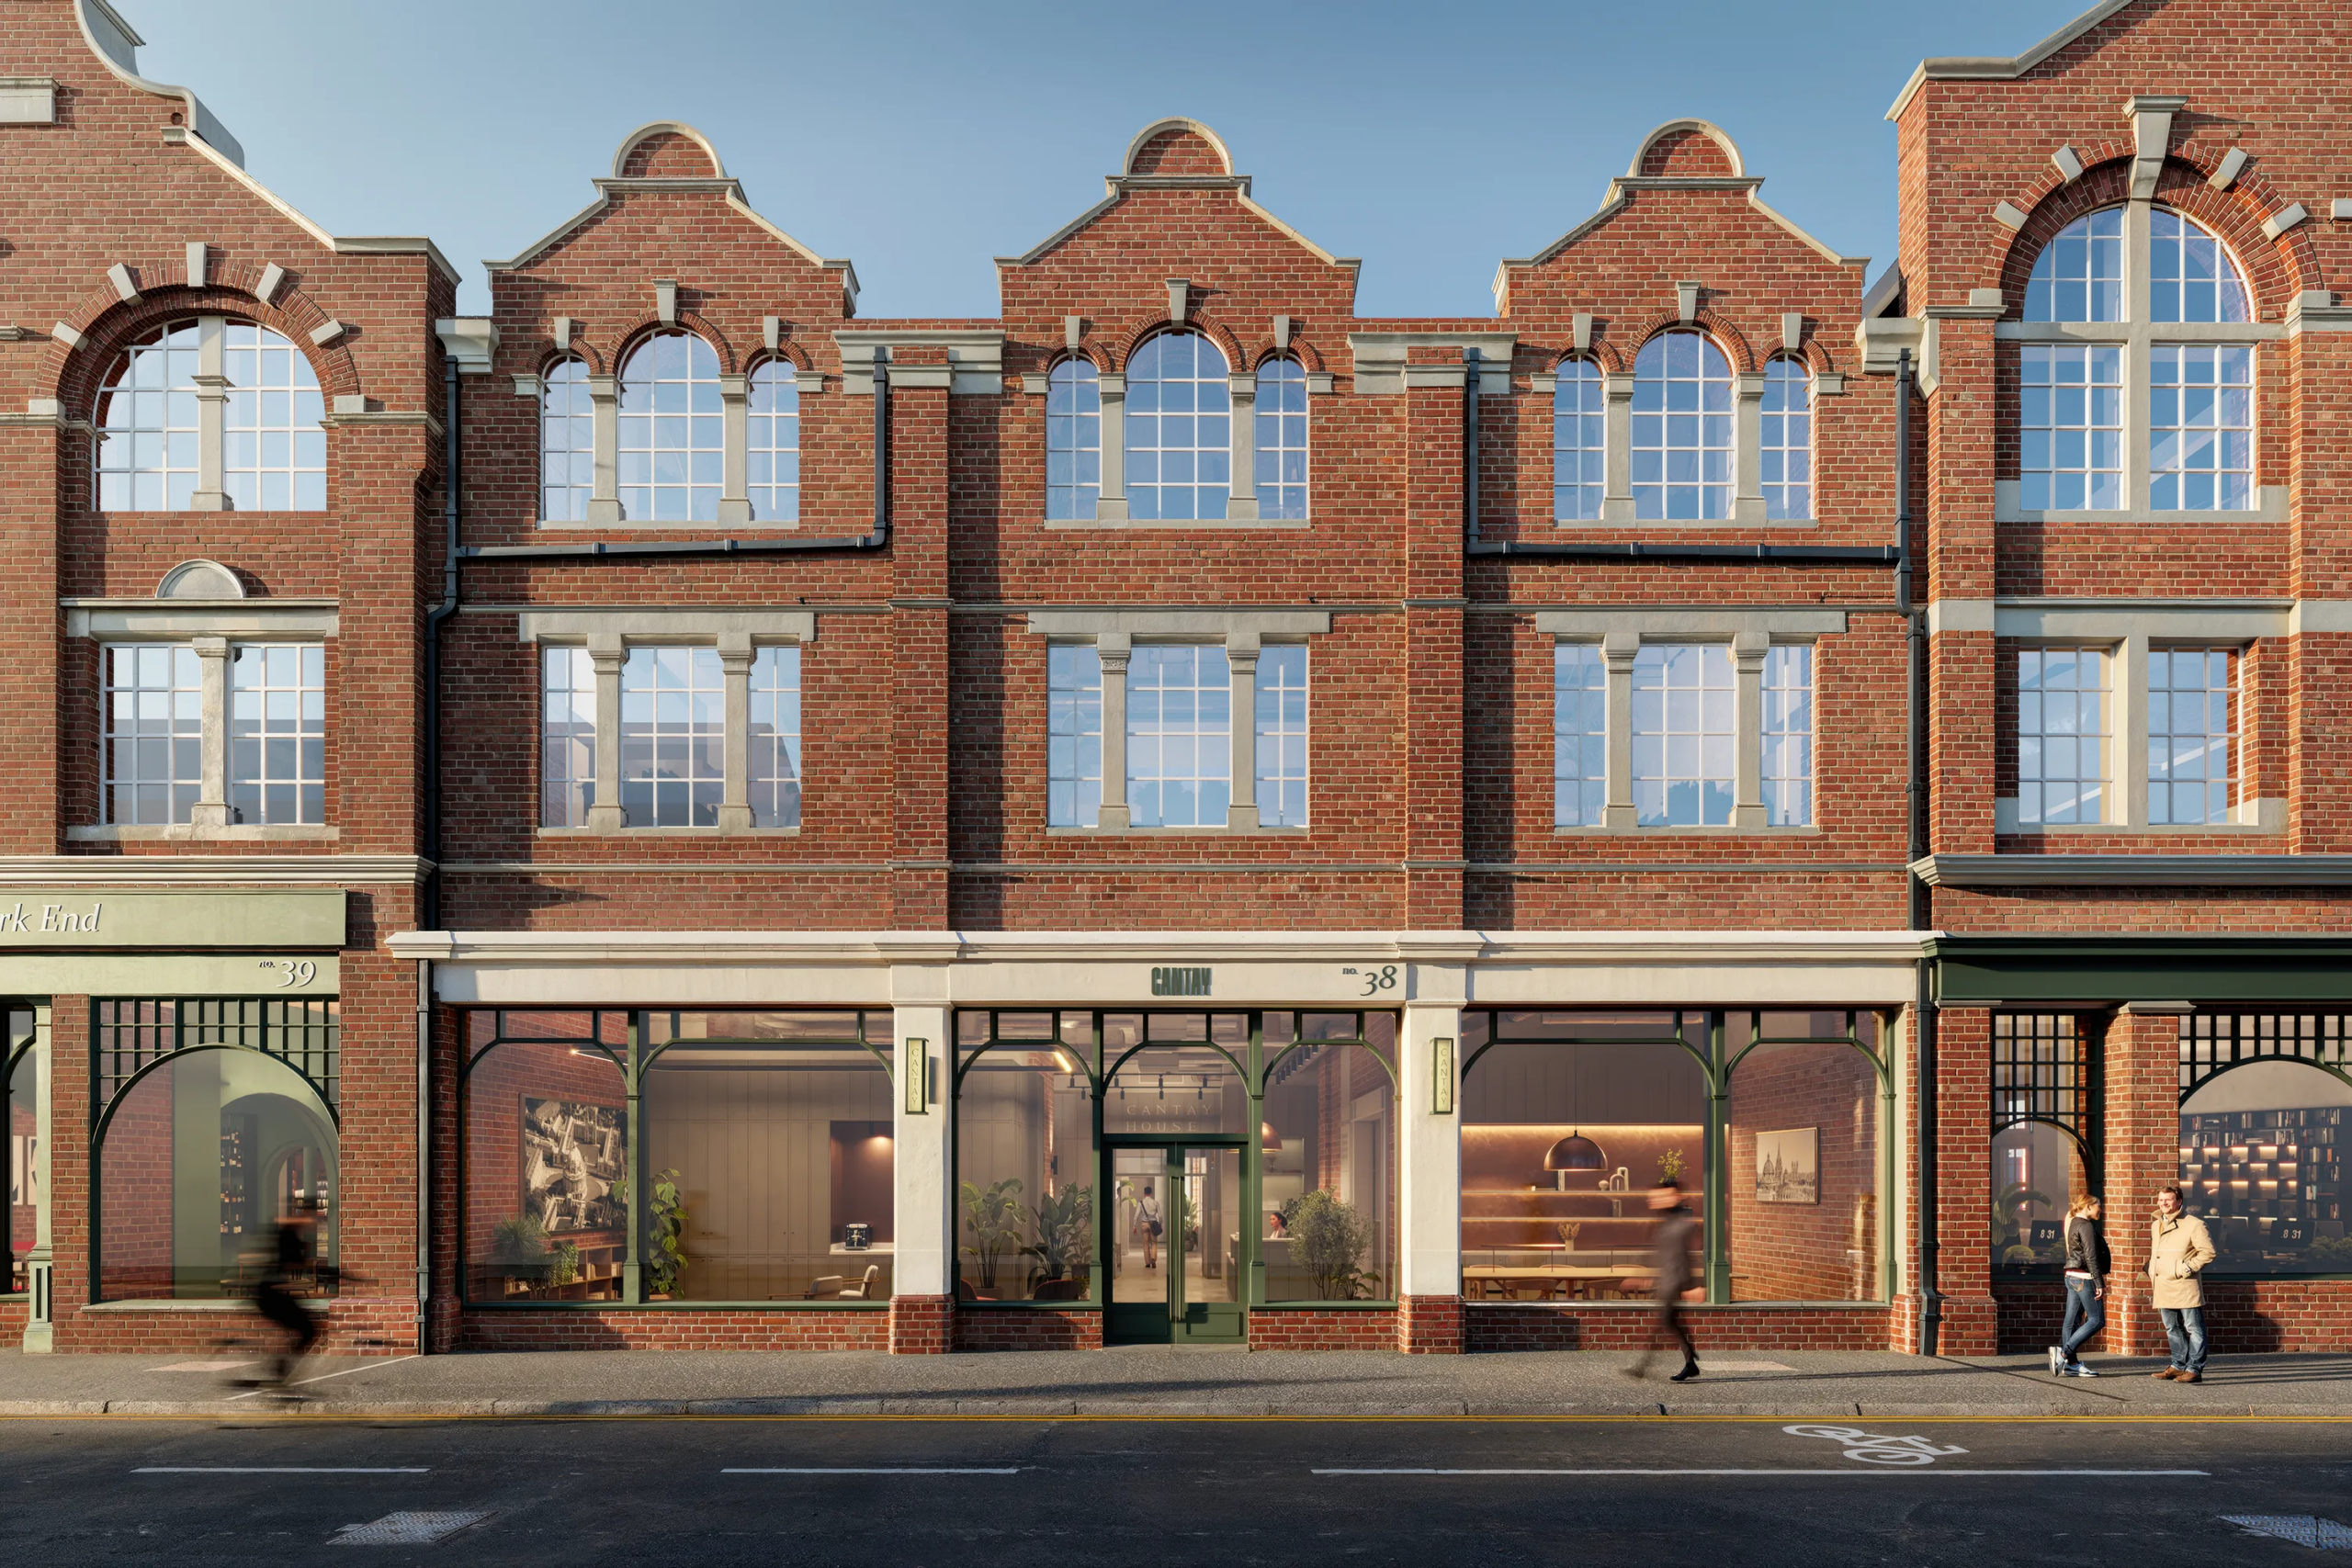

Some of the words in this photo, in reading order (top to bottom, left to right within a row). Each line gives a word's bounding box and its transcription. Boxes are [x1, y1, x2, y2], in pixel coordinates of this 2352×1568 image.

[39, 903, 102, 932] End
[276, 960, 317, 988] 39
[1151, 966, 1212, 997] CANTAY
[1359, 964, 1397, 997] 38
[1440, 1047, 1448, 1105] CANTAY
[1126, 1105, 1212, 1115] CANTAY
[1125, 1122, 1197, 1132] HOUSE
